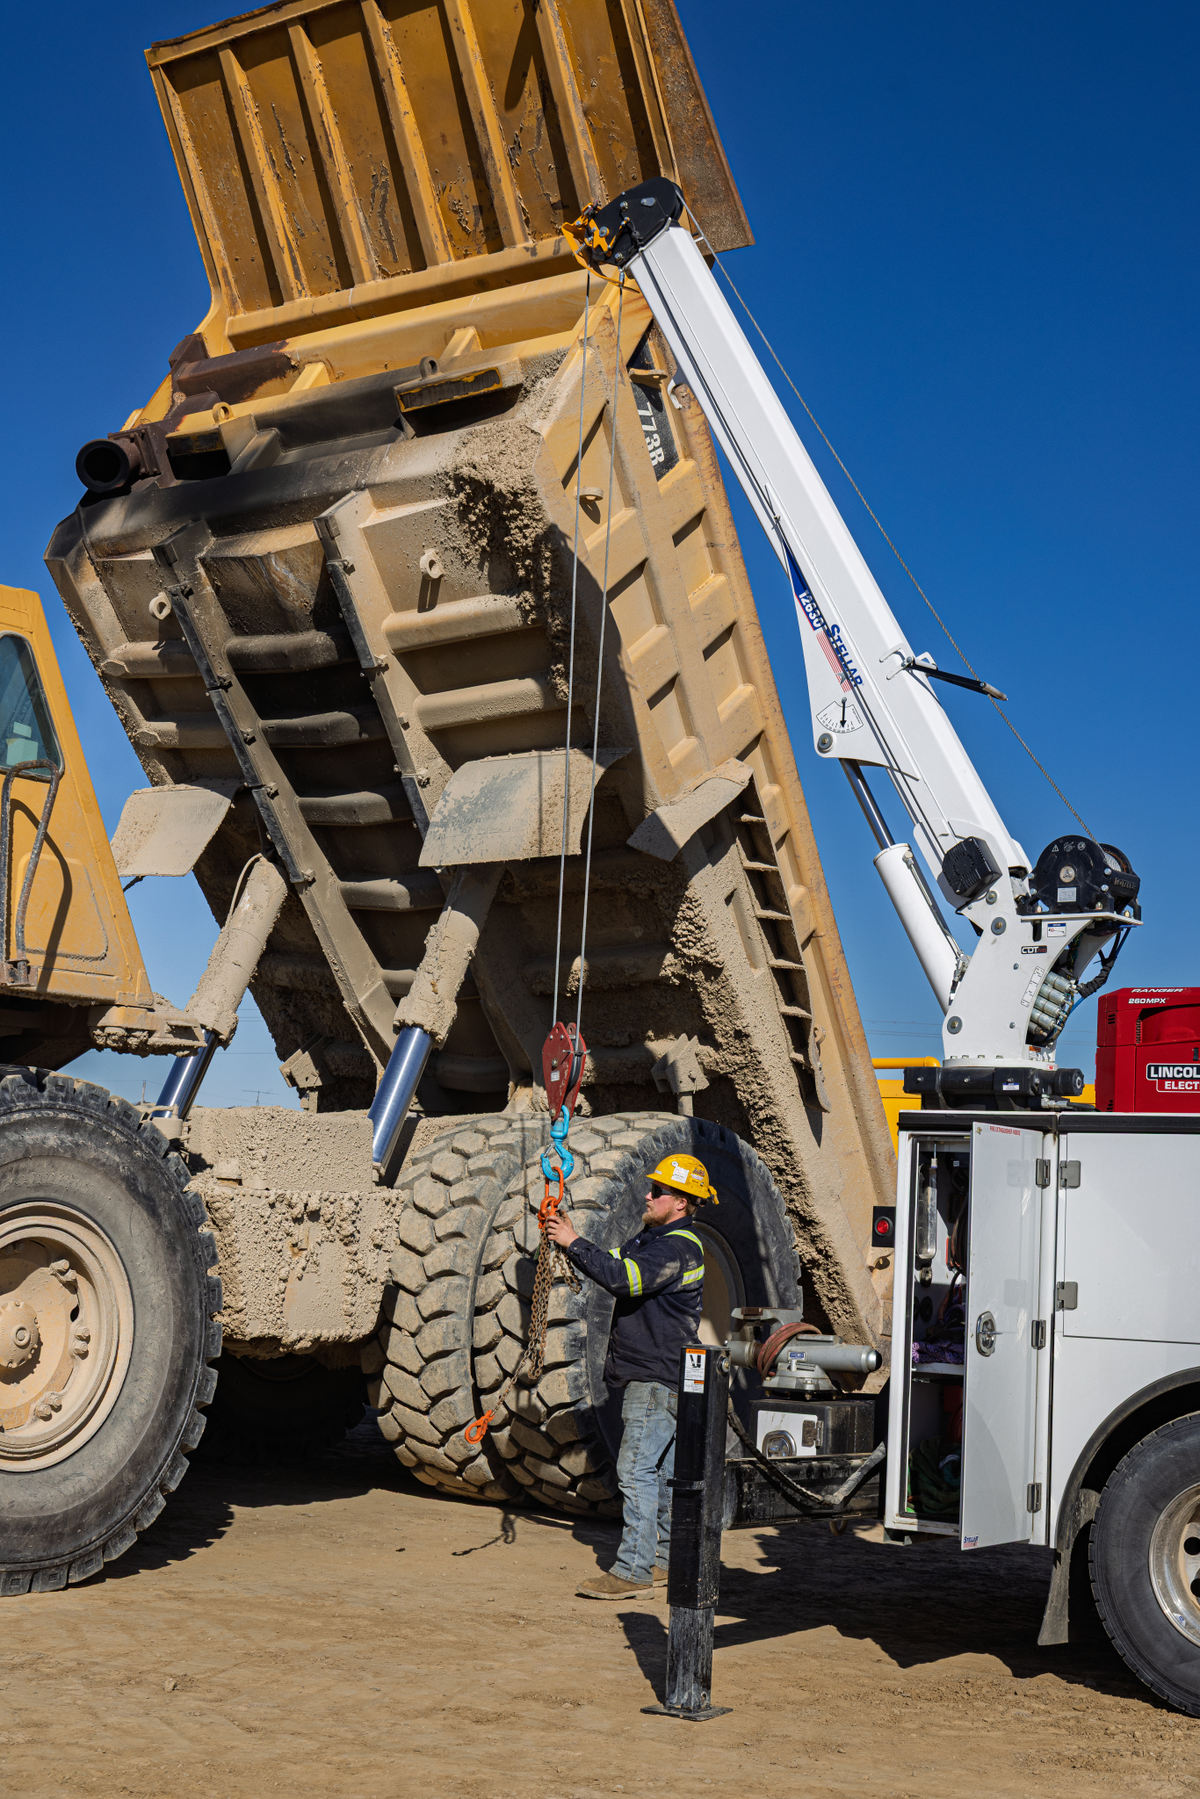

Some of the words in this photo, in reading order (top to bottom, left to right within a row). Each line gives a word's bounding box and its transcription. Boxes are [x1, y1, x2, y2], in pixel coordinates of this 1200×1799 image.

[637, 401, 665, 466] 773B
[799, 590, 825, 628] 12630
[826, 624, 863, 687] STELLAR
[1164, 1081, 1200, 1090] ELECT
